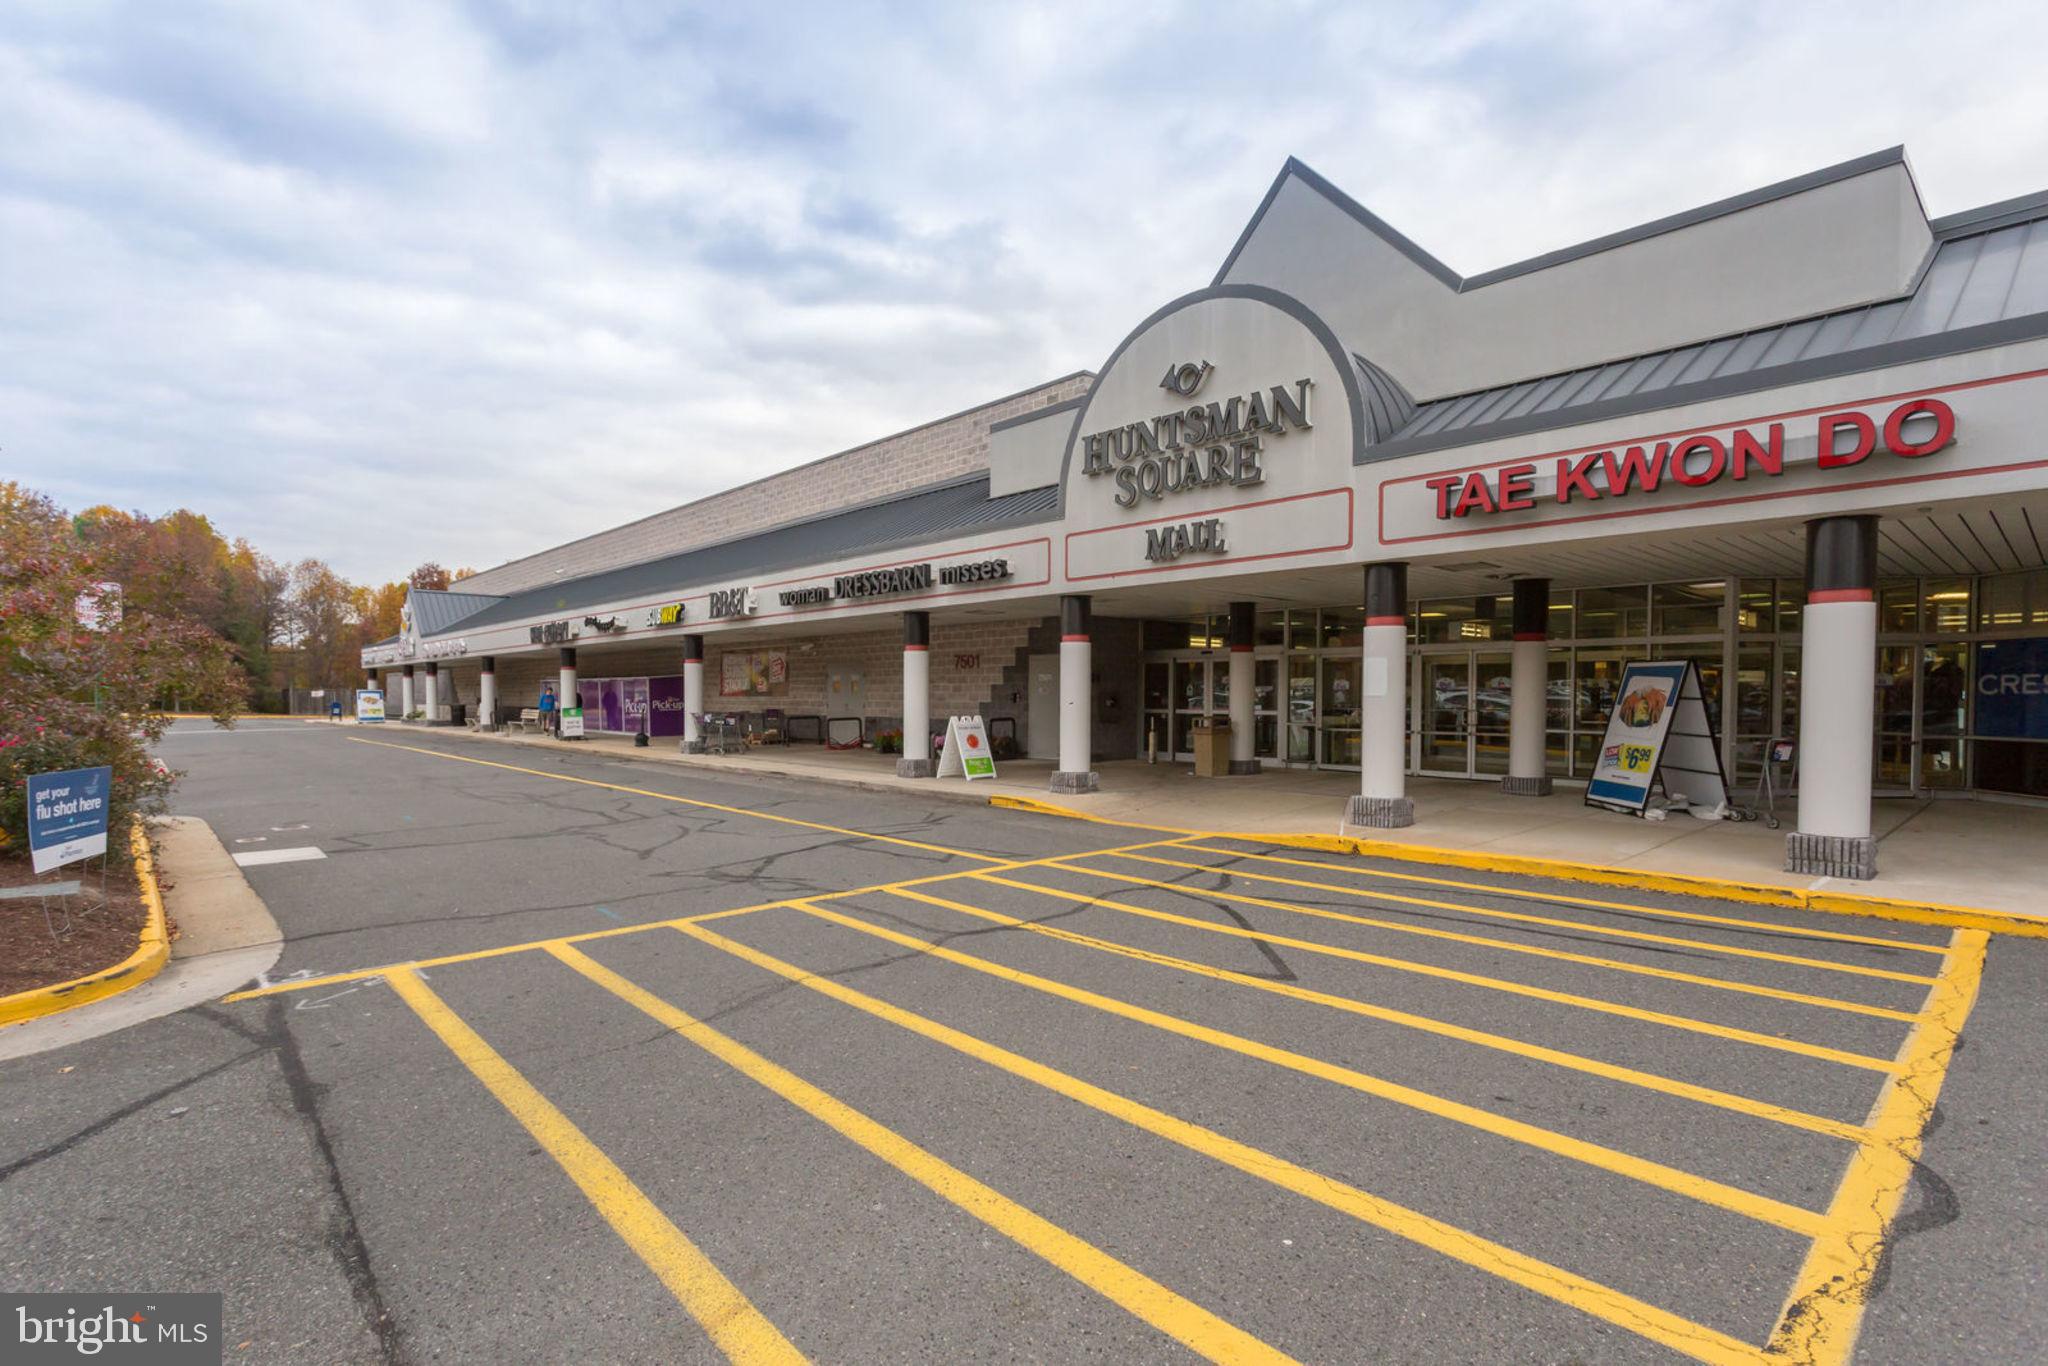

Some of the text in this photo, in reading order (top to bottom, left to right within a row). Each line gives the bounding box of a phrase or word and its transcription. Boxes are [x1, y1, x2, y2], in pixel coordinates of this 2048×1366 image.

[1082, 378, 1313, 476] HUNTSMAN
[1114, 436, 1264, 508] SQUARE
[1426, 398, 1957, 520] TAE KWON DO
[1144, 518, 1227, 562] MALL
[779, 558, 1008, 607] woman DRESSBARN misses
[646, 603, 685, 626] SUBWAY
[708, 586, 750, 619] BB&T
[954, 654, 980, 669] 7501
[35, 787, 70, 803] get your
[36, 797, 102, 820] flu shot here
